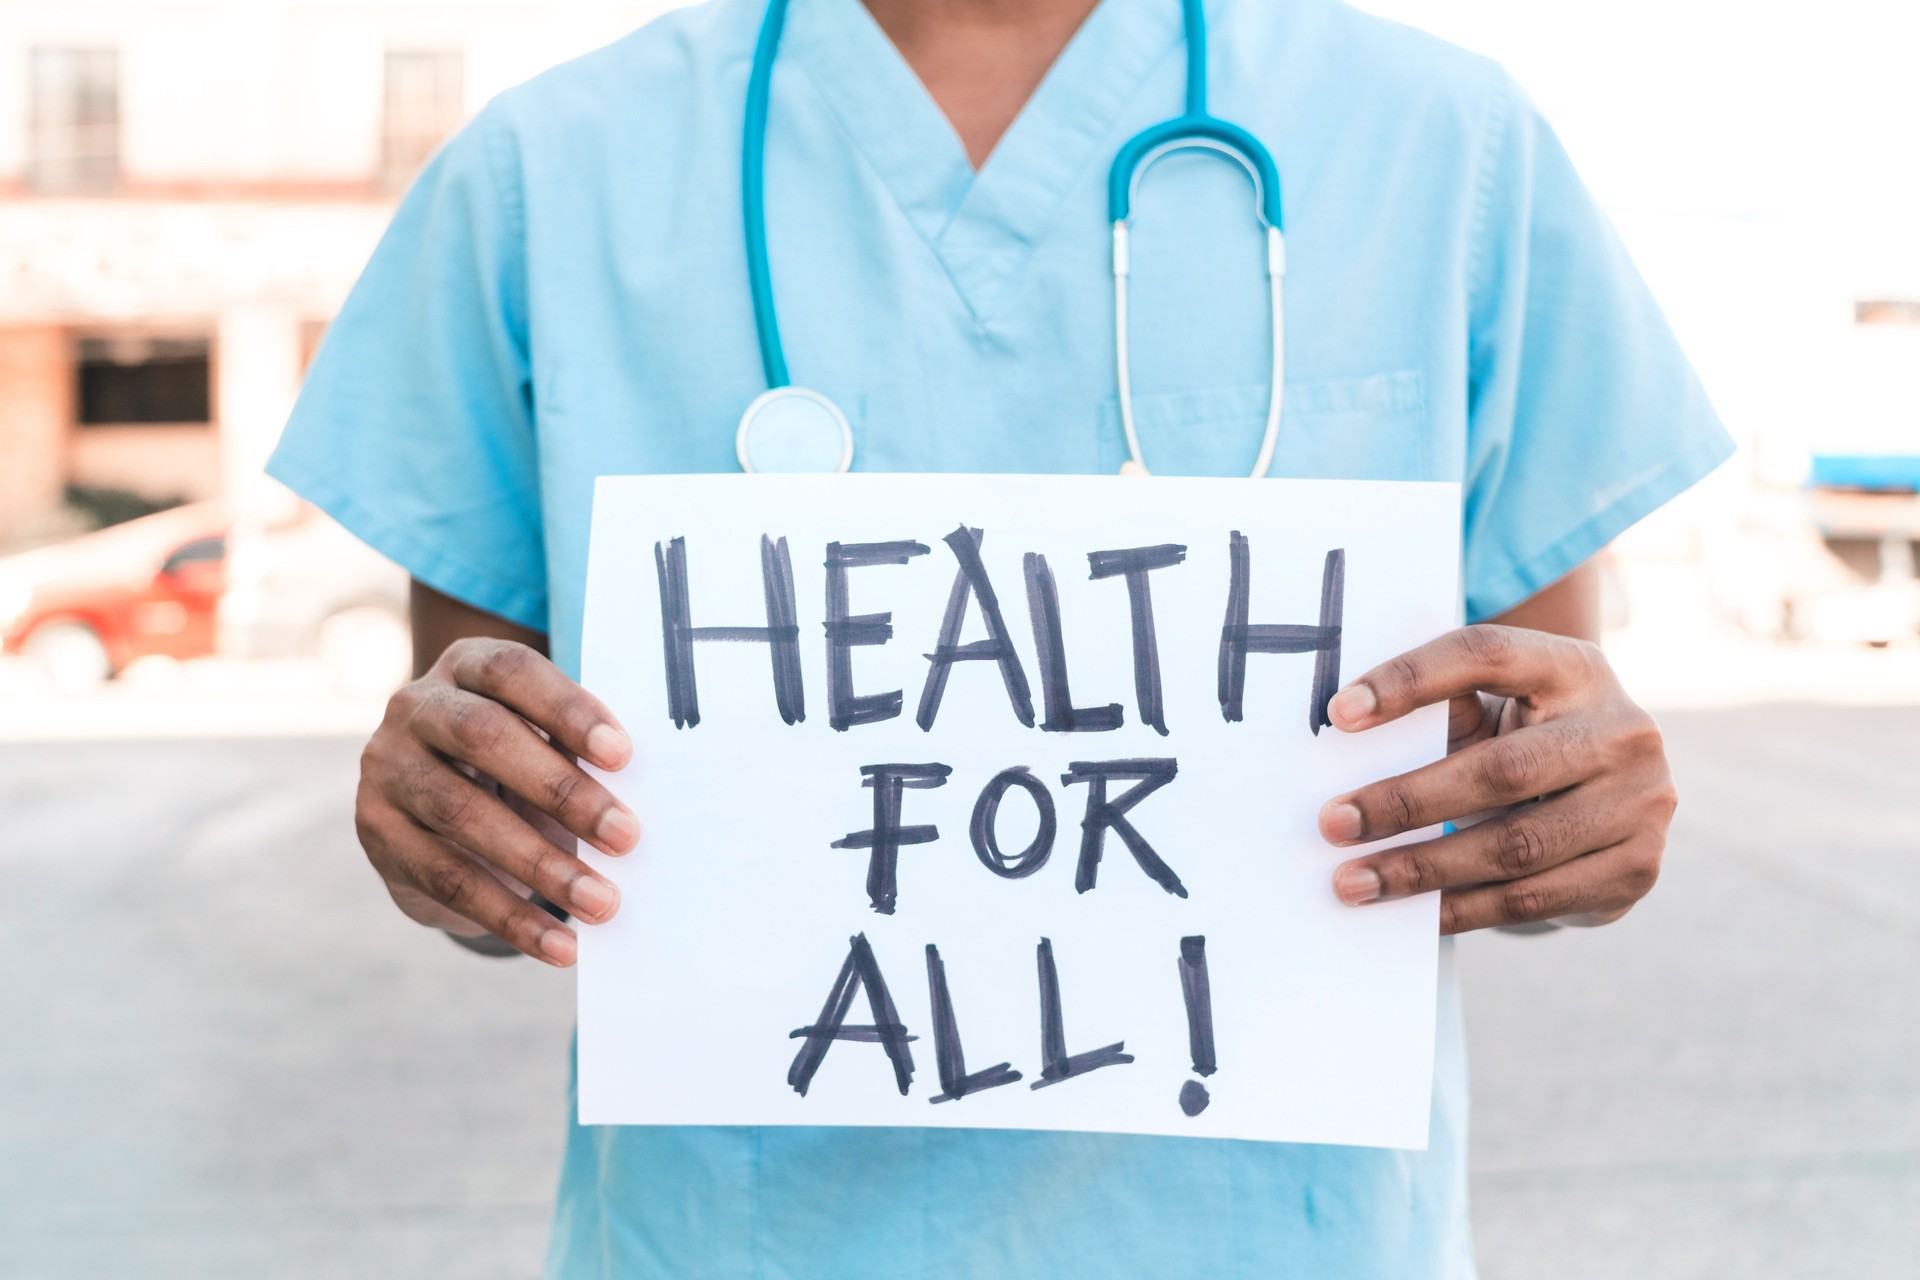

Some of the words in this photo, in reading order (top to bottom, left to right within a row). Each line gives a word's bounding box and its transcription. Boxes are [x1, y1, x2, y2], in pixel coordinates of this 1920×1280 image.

[655, 524, 1345, 736] HEALTH
[831, 757, 1188, 915] FOR
[787, 931, 1218, 1117] ALL!
